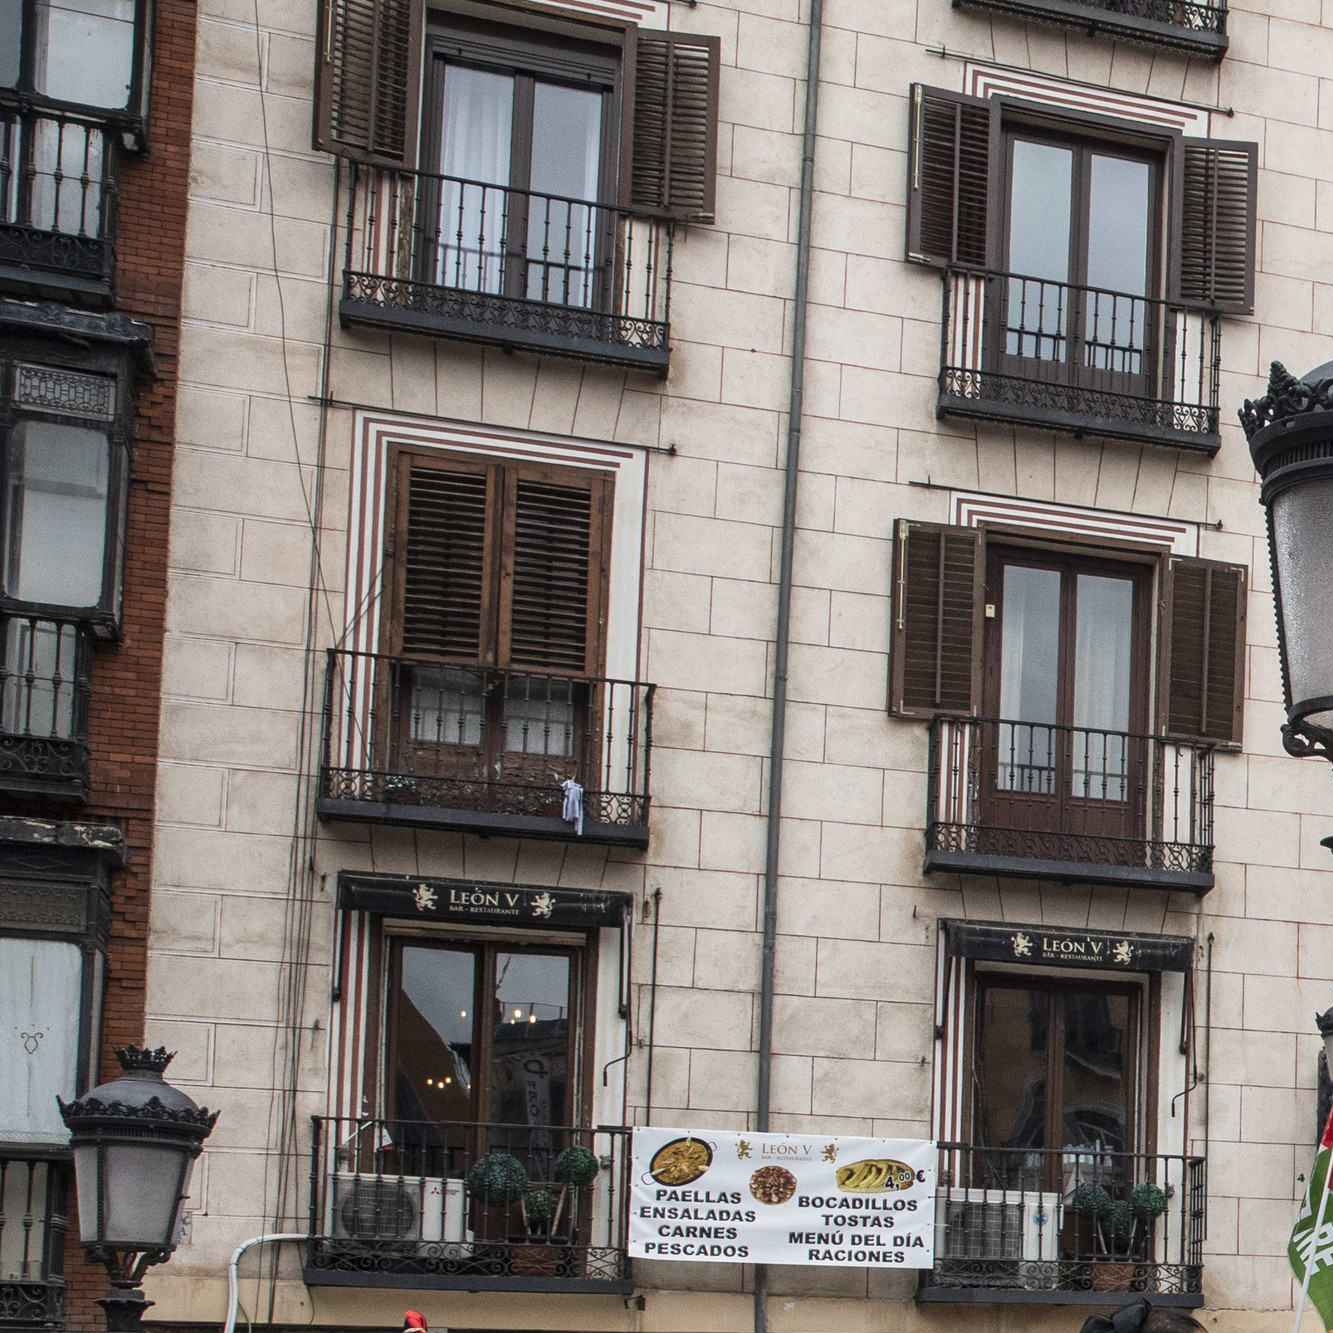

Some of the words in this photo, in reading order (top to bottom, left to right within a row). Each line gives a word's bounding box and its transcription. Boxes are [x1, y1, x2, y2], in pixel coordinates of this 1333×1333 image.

[449, 887, 500, 907] LEÓN
[502, 892, 519, 907] V
[1042, 937, 1086, 953] LEÓN
[1088, 941, 1103, 954] V
[762, 1142, 798, 1155] LEÓN
[802, 1144, 812, 1155] V
[655, 1189, 742, 1205] PAELLAS
[797, 1195, 919, 1212] BOCADILLOS
[639, 1206, 757, 1223] ENSALADAS
[821, 1213, 895, 1229] TOSTAS
[658, 1224, 738, 1240] CARNES
[788, 1229, 844, 1246] MENÚ
[850, 1233, 887, 1247] DEL
[892, 1232, 925, 1249] DÍA
[644, 1242, 750, 1258] PESCADOS
[808, 1248, 905, 1264] RACIONES
